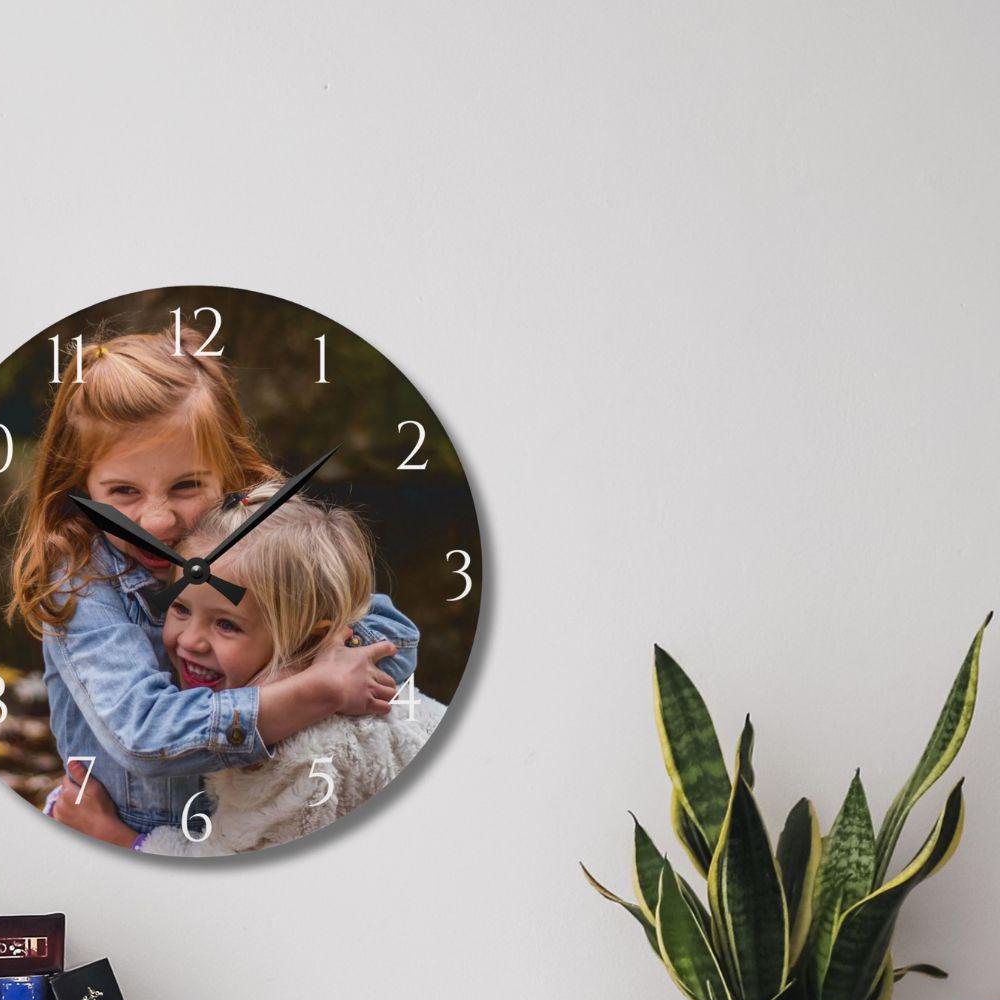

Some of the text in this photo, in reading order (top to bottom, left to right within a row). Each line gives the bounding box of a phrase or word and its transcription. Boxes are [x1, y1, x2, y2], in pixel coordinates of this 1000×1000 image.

[169, 306, 226, 357] 12
[47, 333, 86, 384] 11
[314, 333, 331, 384] 1
[396, 420, 430, 470] 2
[445, 549, 473, 602] 3
[388, 672, 422, 722] 4
[66, 756, 97, 804] 7
[308, 757, 335, 806] 5
[180, 790, 213, 842] 6
